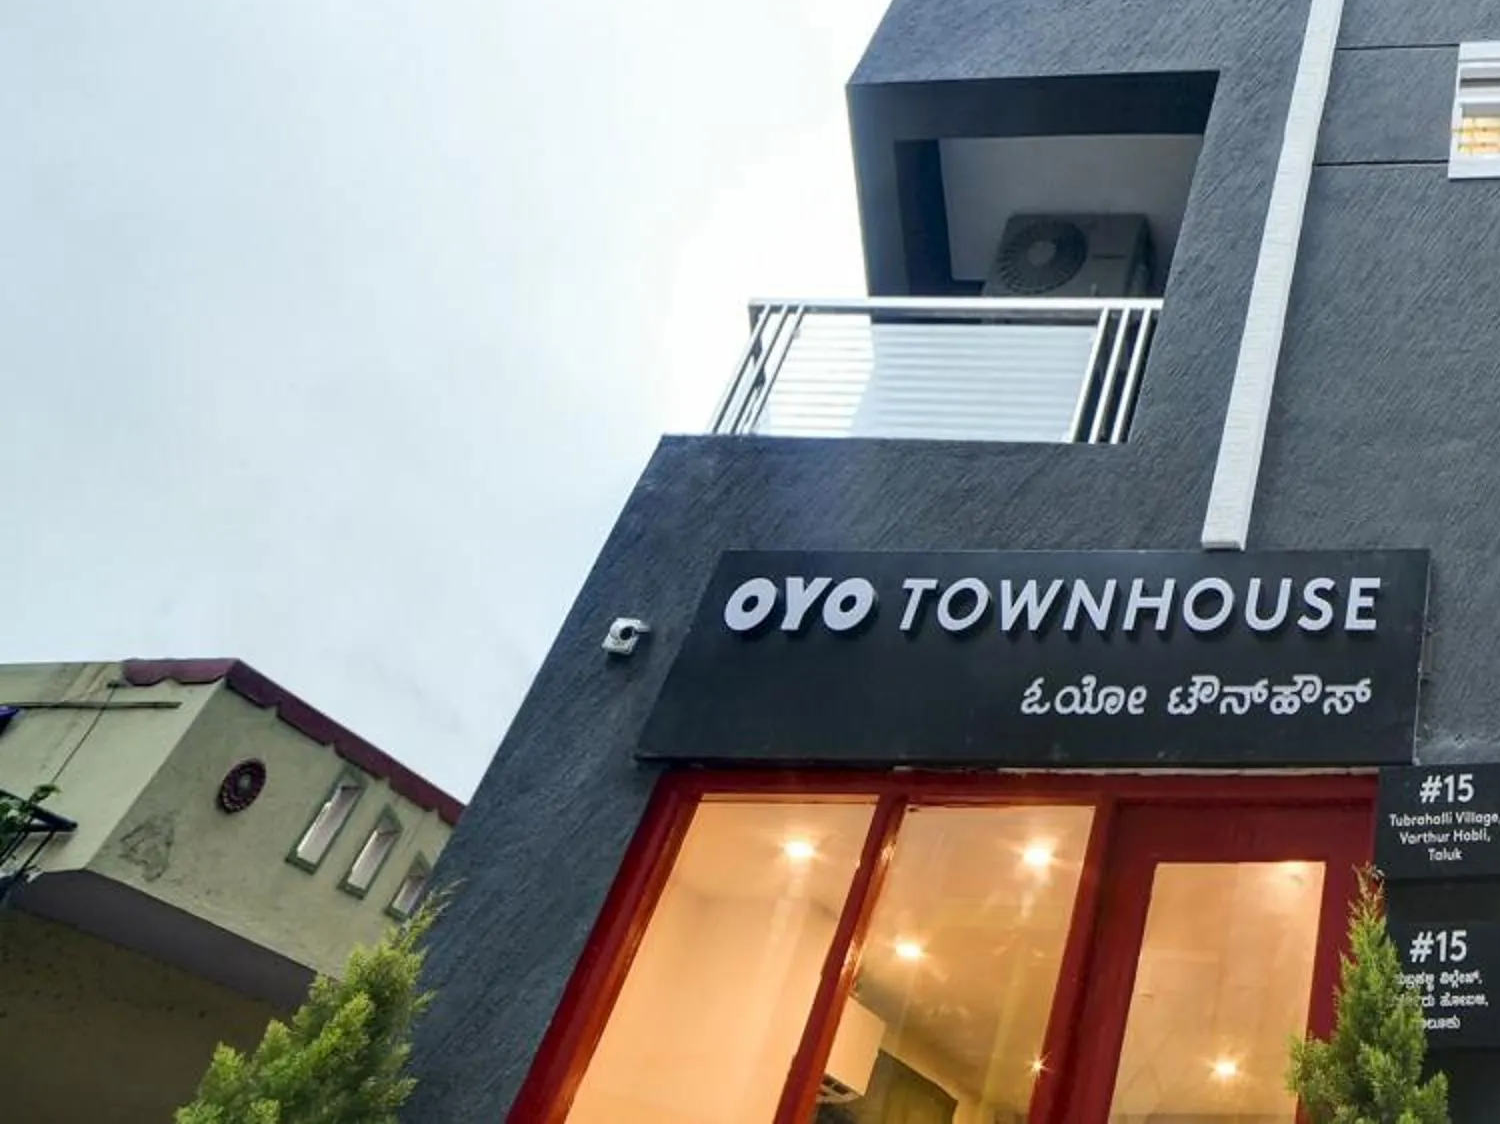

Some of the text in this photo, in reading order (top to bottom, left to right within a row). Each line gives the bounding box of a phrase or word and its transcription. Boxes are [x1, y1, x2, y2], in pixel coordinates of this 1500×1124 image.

[724, 576, 1382, 632] OYO TOWNHOUSE
[1020, 674, 1148, 716] ಓಯೋ
[1418, 773, 1475, 804] #15
[1389, 813, 1453, 827] Tubrahalli
[1399, 828, 1491, 845] Varthur Hobli,
[1427, 847, 1463, 861] Taluk
[1409, 929, 1468, 963] #15
